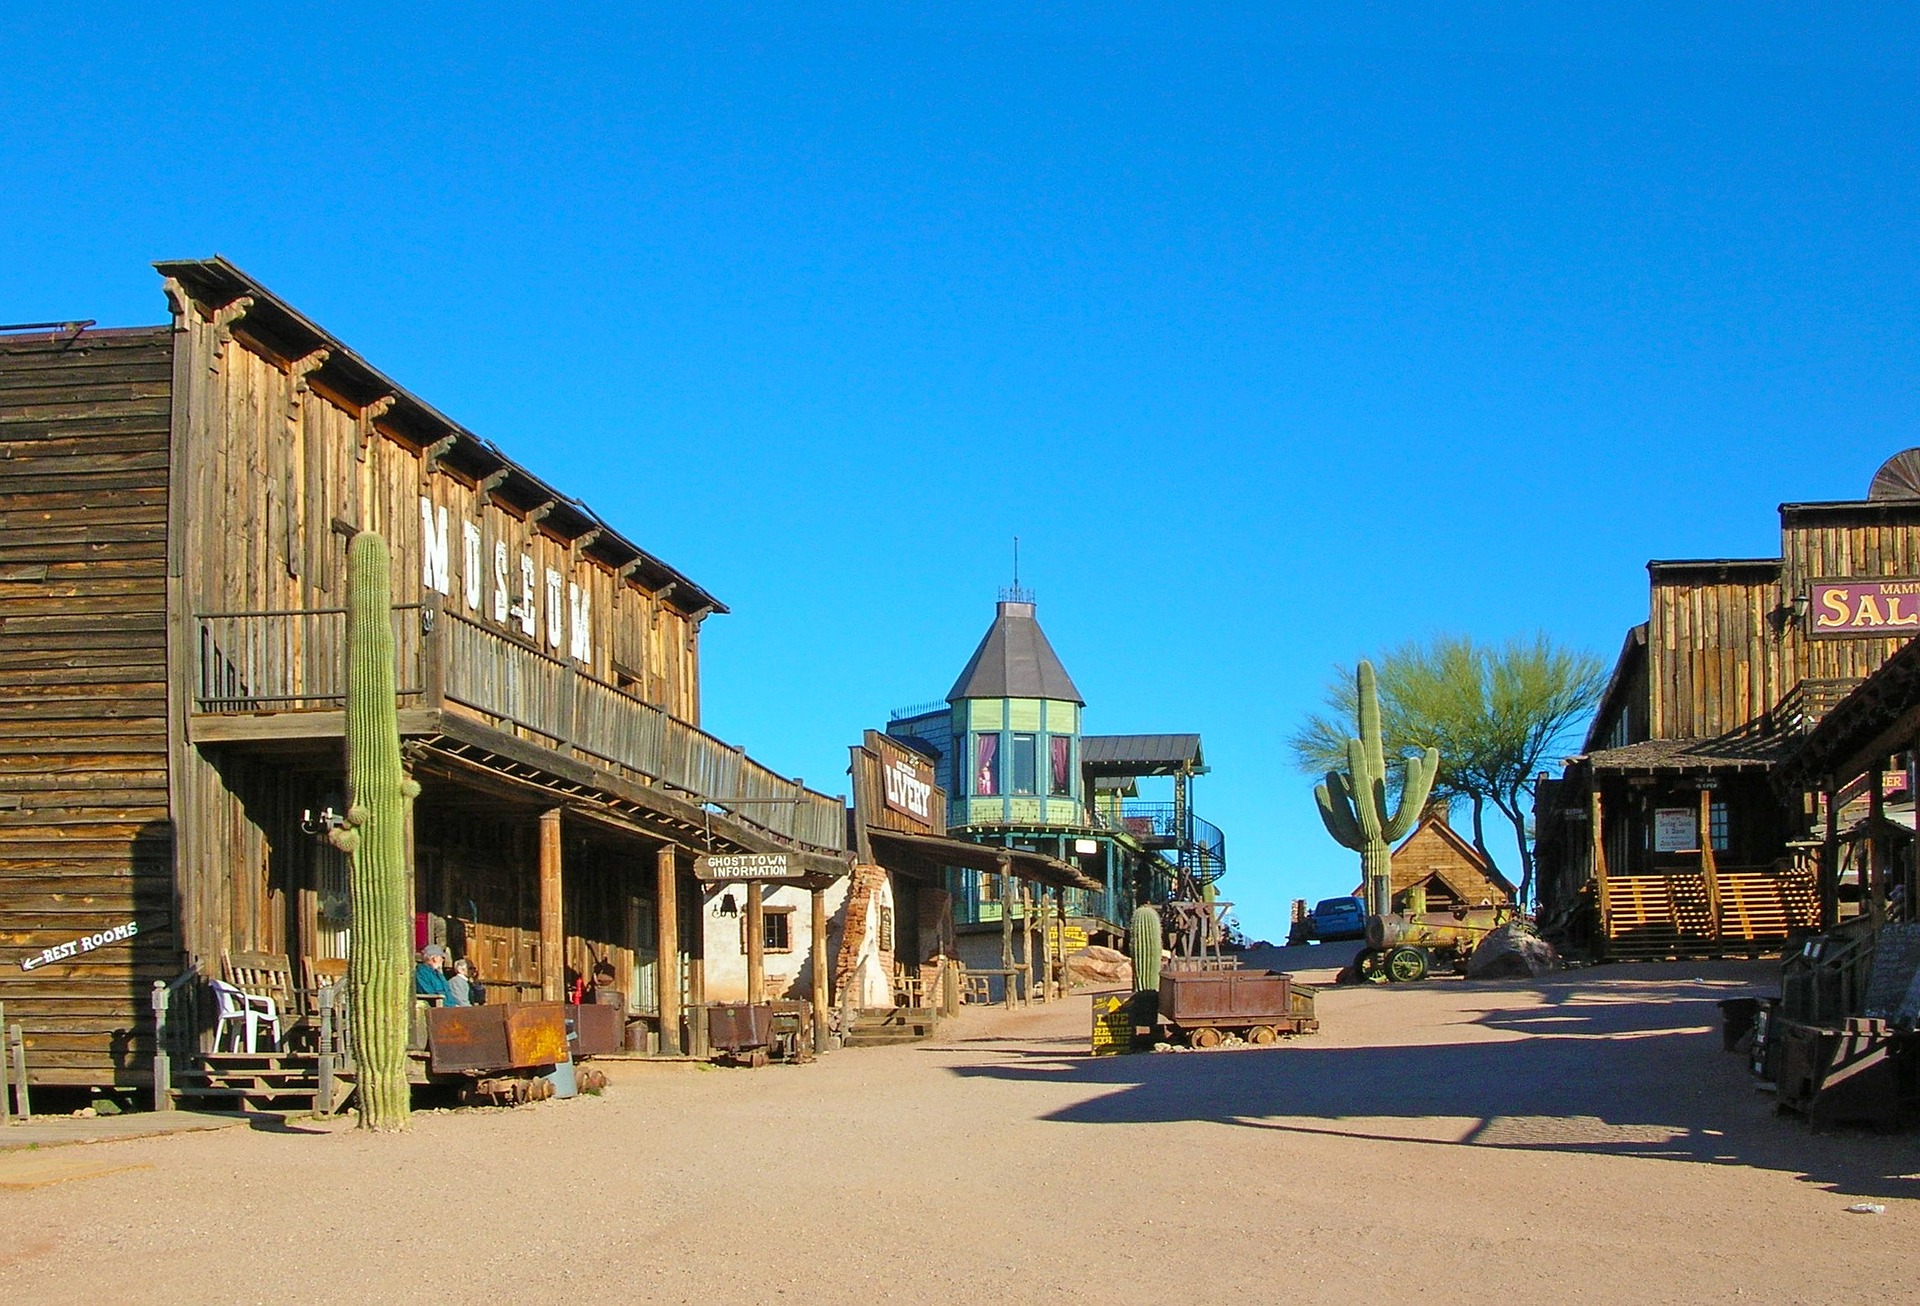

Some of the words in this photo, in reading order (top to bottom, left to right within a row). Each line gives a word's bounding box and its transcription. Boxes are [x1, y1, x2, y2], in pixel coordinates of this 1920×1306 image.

[421, 496, 591, 664] MUSEUM
[1817, 588, 1918, 627] SAL
[885, 764, 931, 818] LIVERY
[713, 866, 787, 878] INFORMATION
[749, 855, 787, 867] TOWN
[42, 940, 77, 963] REST
[80, 921, 139, 952] ROOMS
[1096, 1013, 1129, 1026] LIVE
